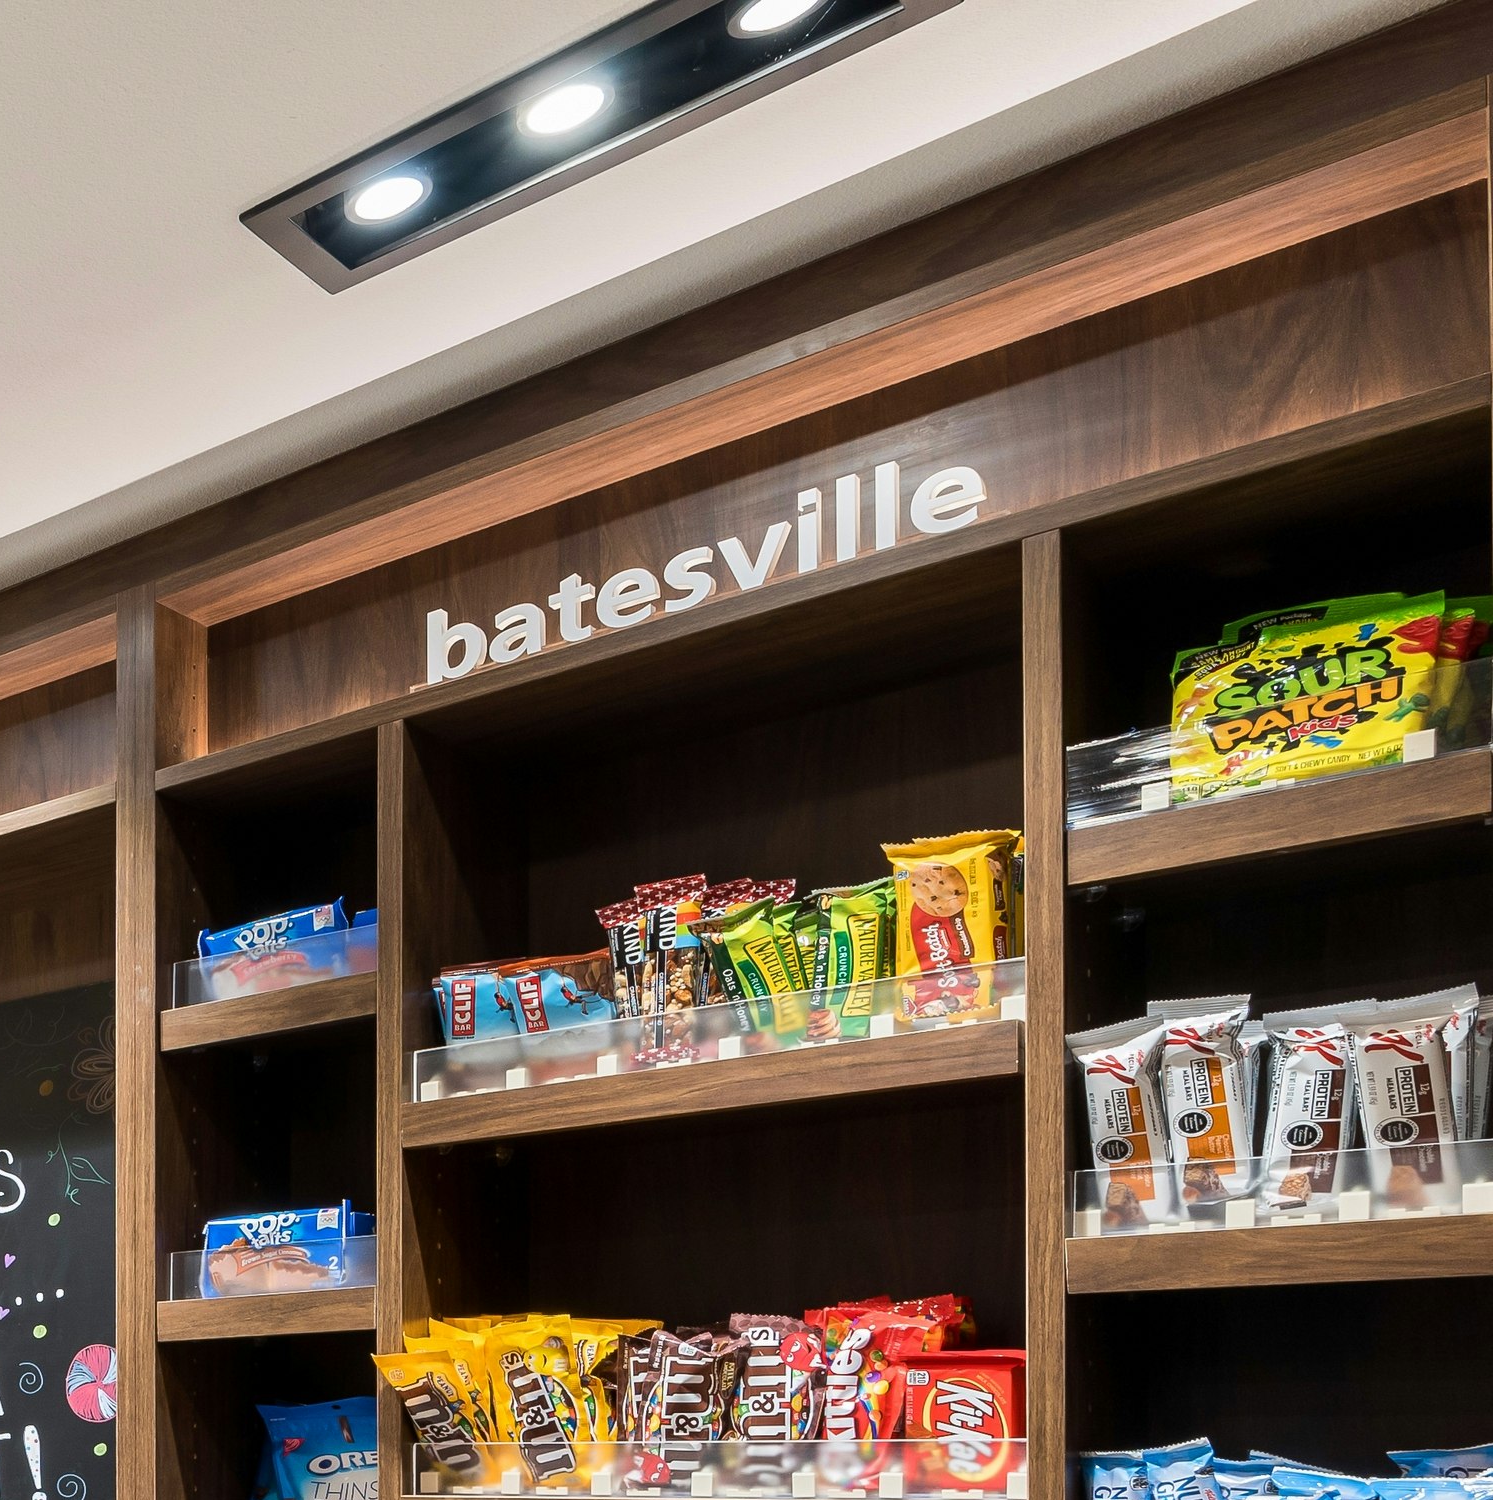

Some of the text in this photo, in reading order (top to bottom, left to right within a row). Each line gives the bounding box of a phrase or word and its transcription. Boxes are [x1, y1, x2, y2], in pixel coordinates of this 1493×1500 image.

[426, 460, 987, 685] batesville
[1215, 649, 1387, 716] SOUR
[1213, 677, 1398, 750] PATCH
[1288, 714, 1358, 742] Kids
[1301, 755, 1351, 770] CHEWY CANDY
[623, 922, 640, 965] KIND
[659, 906, 676, 950] KIND
[818, 937, 828, 959] Oats
[853, 918, 878, 971] NATURE
[723, 968, 735, 991] Oats
[751, 941, 784, 988] NATURE
[454, 983, 472, 1023] CLIF
[519, 981, 540, 1020] CLIF
[455, 1024, 472, 1032] BAR
[528, 1021, 545, 1030] BAR
[1194, 1060, 1210, 1104] PROTEIN
[1315, 1072, 1329, 1117] PROTEIN
[1400, 1069, 1417, 1113] PROTEIN
[1106, 1114, 1114, 1129] BARS
[1115, 1091, 1130, 1133] PROTEIN
[435, 1376, 455, 1398] PEANUT
[936, 1379, 993, 1435] Kit
[311, 1481, 378, 1500] THINS
